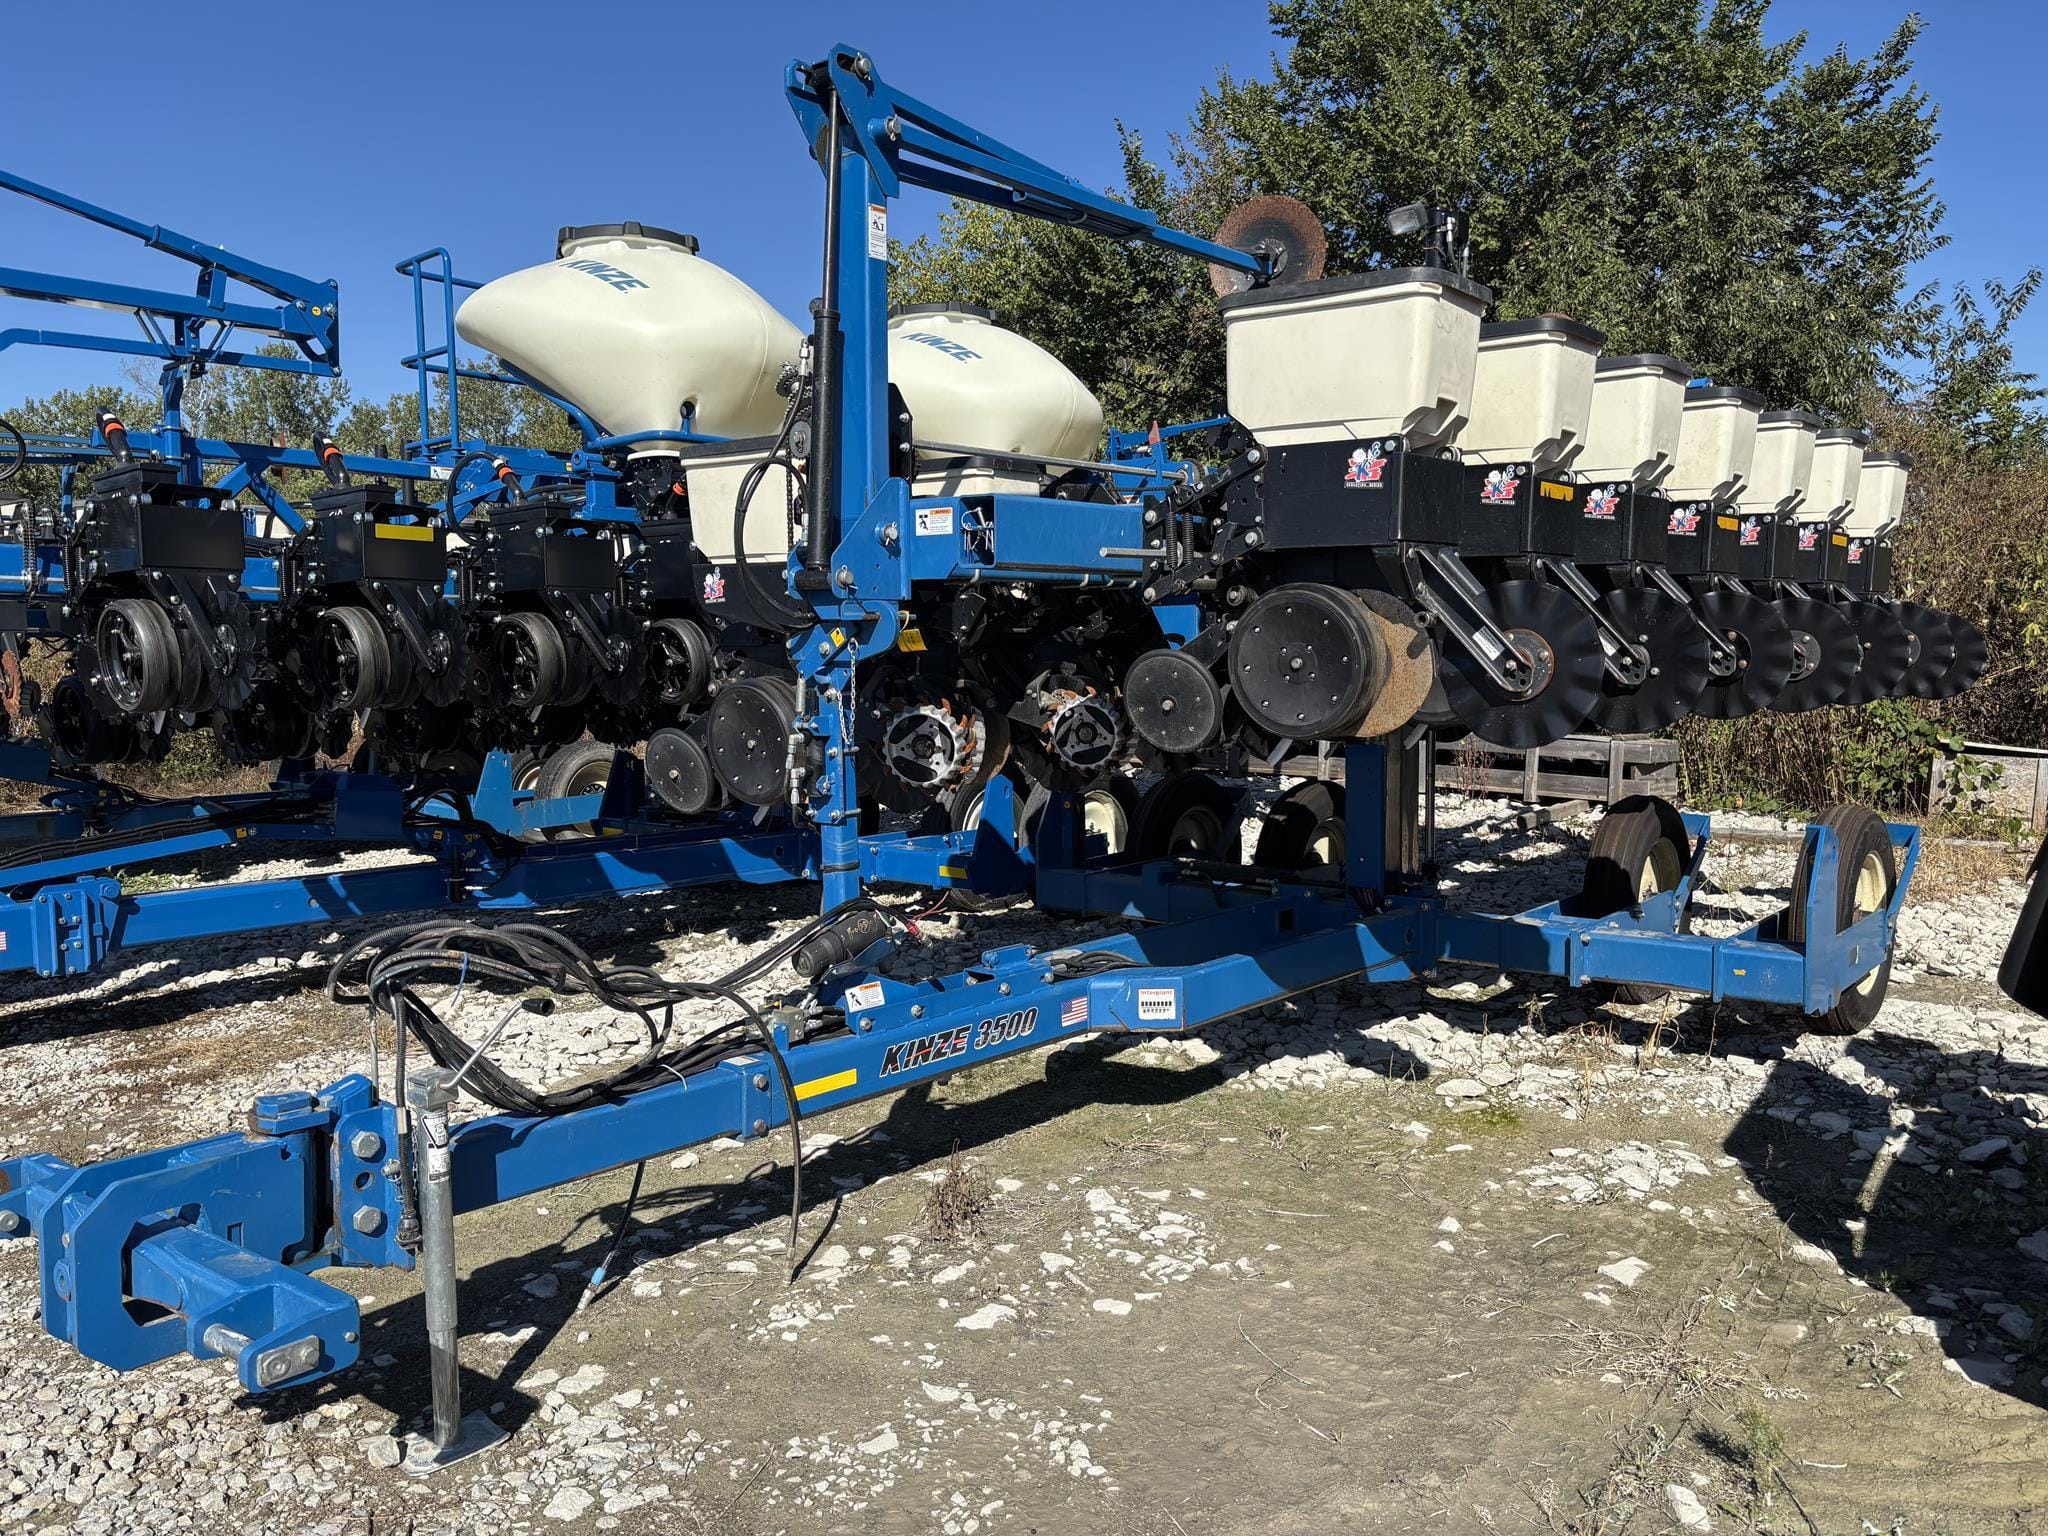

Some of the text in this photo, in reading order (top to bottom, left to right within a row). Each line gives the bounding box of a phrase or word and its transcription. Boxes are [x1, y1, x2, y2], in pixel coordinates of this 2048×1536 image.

[558, 260, 650, 291] KINZE
[900, 333, 983, 361] KINZE
[879, 1006, 1039, 1077] KINZE 3500
